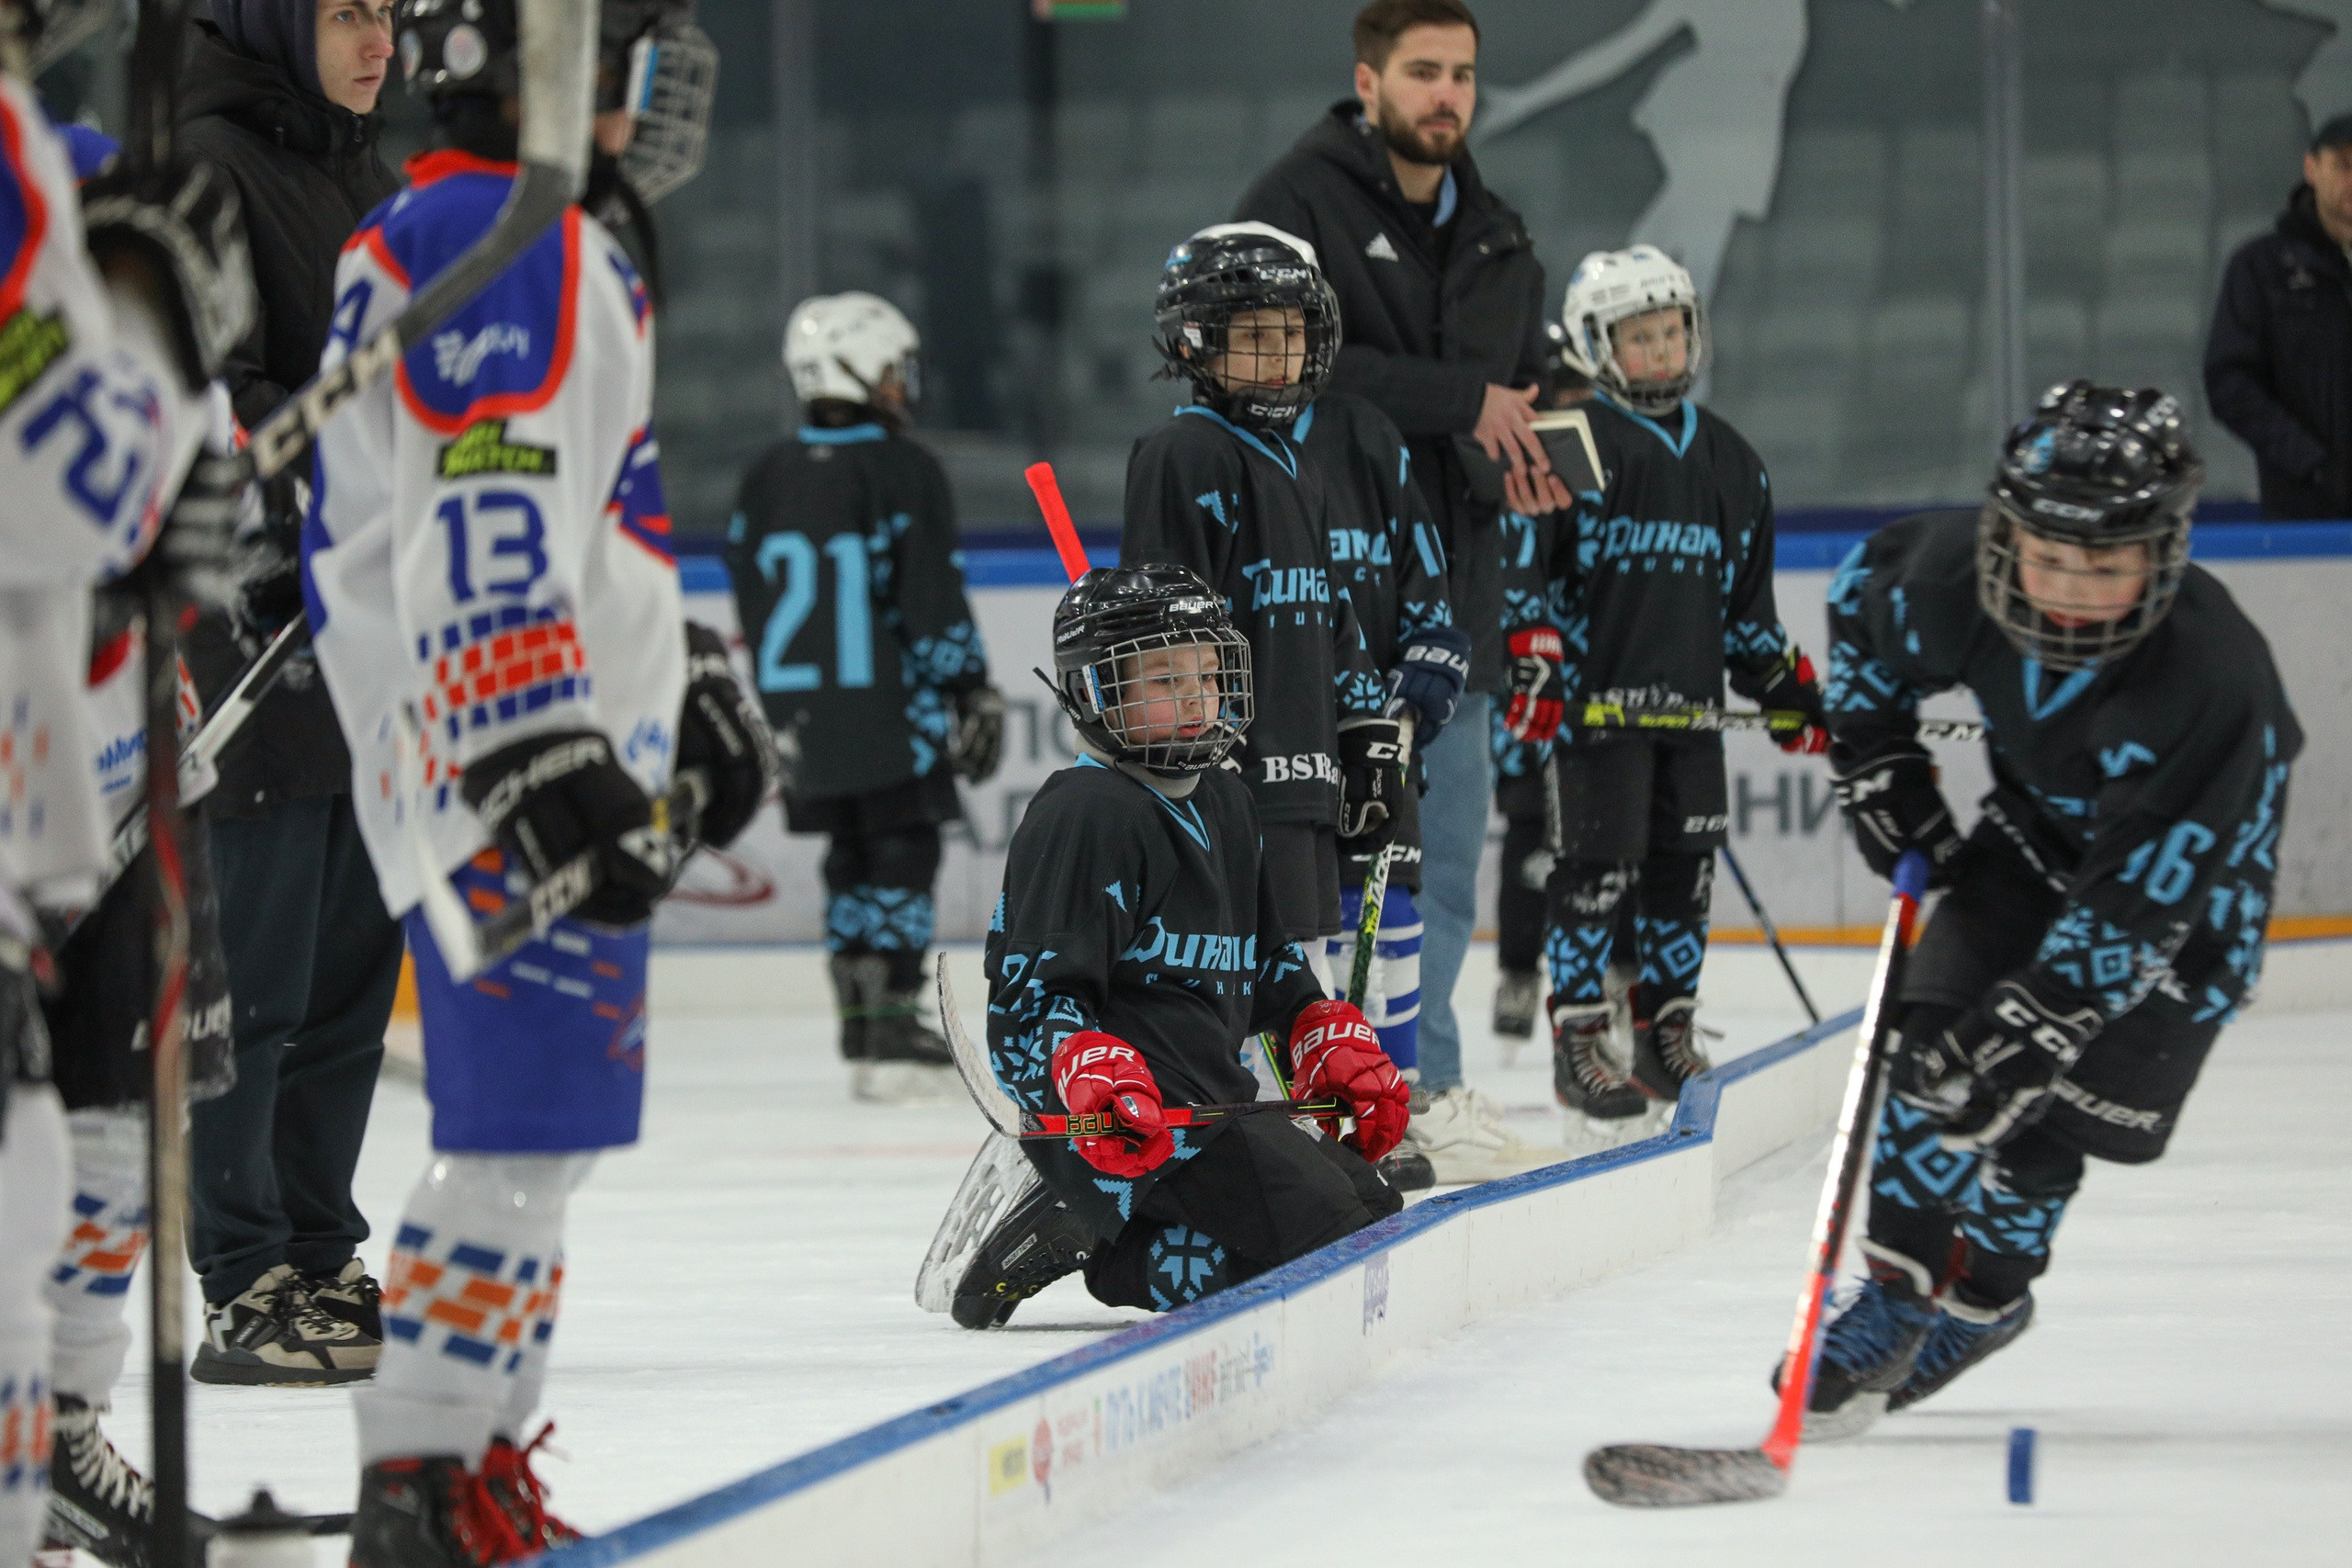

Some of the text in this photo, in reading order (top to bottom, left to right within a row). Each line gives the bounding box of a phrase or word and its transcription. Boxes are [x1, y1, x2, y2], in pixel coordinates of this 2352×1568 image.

[436, 491, 548, 602] 13
[756, 530, 874, 694] 21
[1169, 600, 1215, 613] BAUER
[1404, 645, 1470, 679] BAU
[1057, 1045, 1136, 1111] AUER
[1066, 1112, 1125, 1135] BAU
